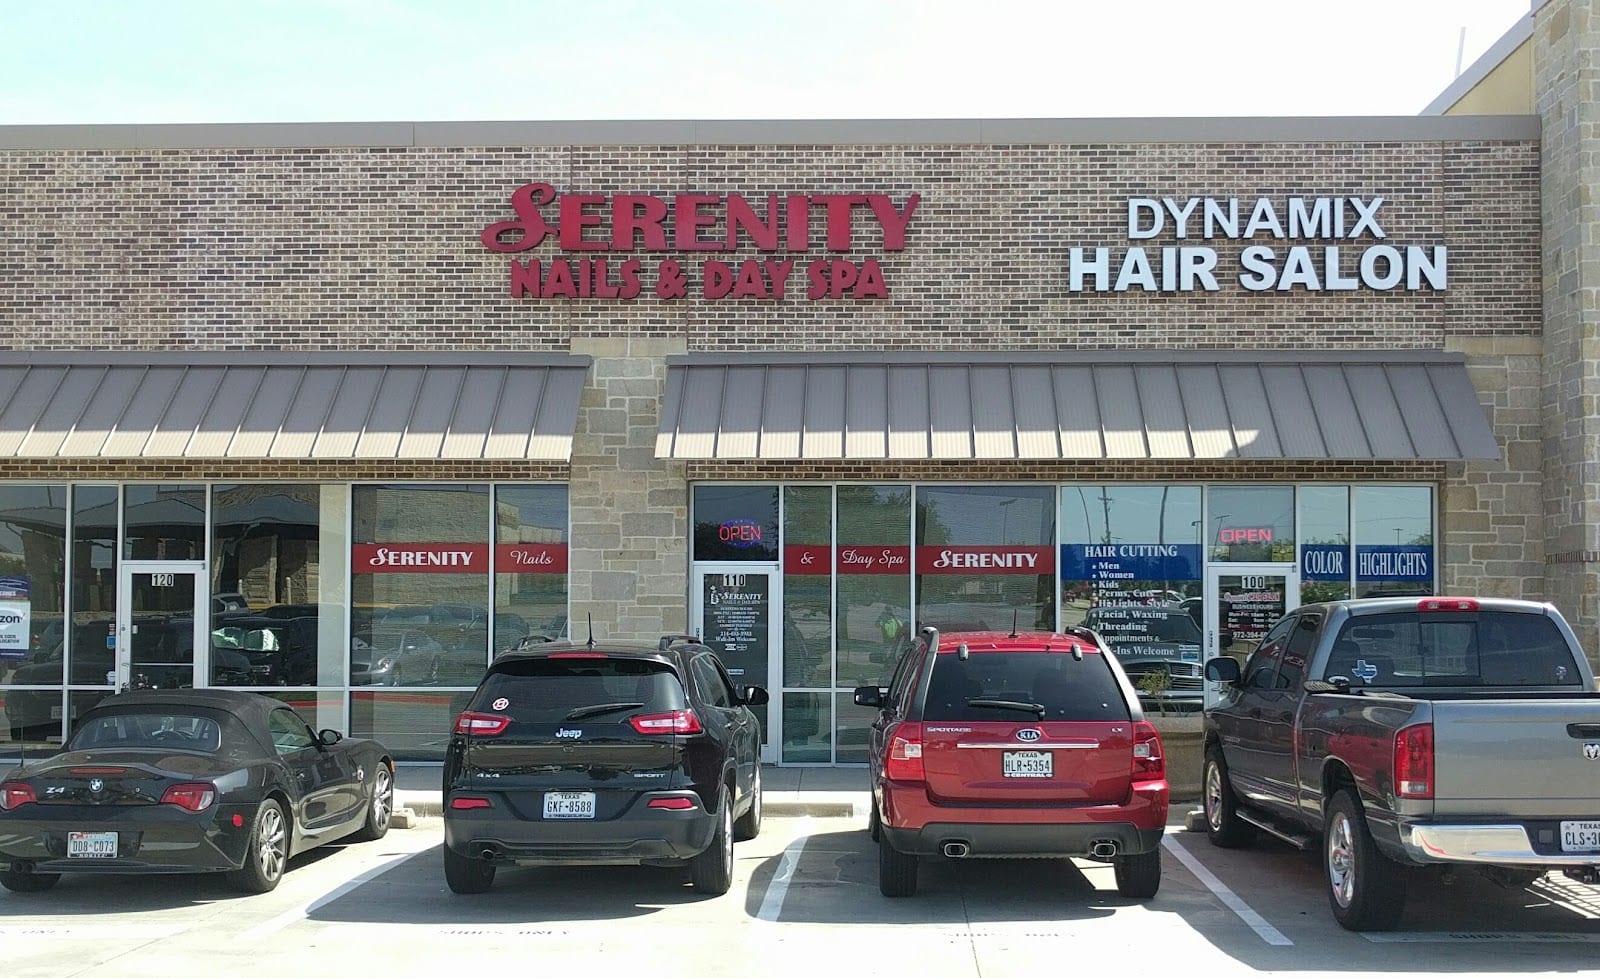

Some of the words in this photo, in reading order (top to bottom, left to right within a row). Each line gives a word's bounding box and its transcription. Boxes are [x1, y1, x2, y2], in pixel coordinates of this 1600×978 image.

[480, 182, 921, 252] SERENITY
[1127, 198, 1386, 239] DYNAMIX
[1069, 246, 1220, 291] HAIR
[1239, 245, 1447, 291] SALON
[510, 259, 641, 299] NAILS
[656, 259, 688, 299] &
[704, 260, 794, 299] DAY
[808, 259, 889, 299] SPA
[719, 525, 761, 541] OPEN
[1220, 528, 1273, 542] OPEN
[370, 548, 473, 566] SERENITY
[1084, 546, 1116, 557] HAIR
[1120, 545, 1178, 557] CUTTING
[510, 551, 554, 565] Nails
[800, 552, 815, 565] &
[842, 550, 875, 569] Day
[879, 550, 905, 569] Spa
[933, 551, 1038, 569] SERENITY
[1304, 551, 1344, 574] COLOR
[1359, 552, 1427, 576] HIGHLIGHTS
[1098, 562, 1120, 570] Men
[153, 574, 173, 586] 120
[724, 574, 745, 586] 110
[1099, 571, 1134, 579] Women
[1099, 581, 1119, 589] Kids
[1242, 576, 1264, 588] 100
[721, 591, 763, 600] SERENITY
[1099, 590, 1131, 598] Perms,
[1133, 589, 1154, 598] Cuts
[1147, 599, 1170, 609] Style
[1099, 610, 1129, 619] Facial,
[1132, 610, 1168, 620] Waxing
[1099, 623, 1147, 632] Threading
[1133, 646, 1175, 655] Welcome
[555, 728, 582, 739] Jeep
[1020, 731, 1037, 739] KIA
